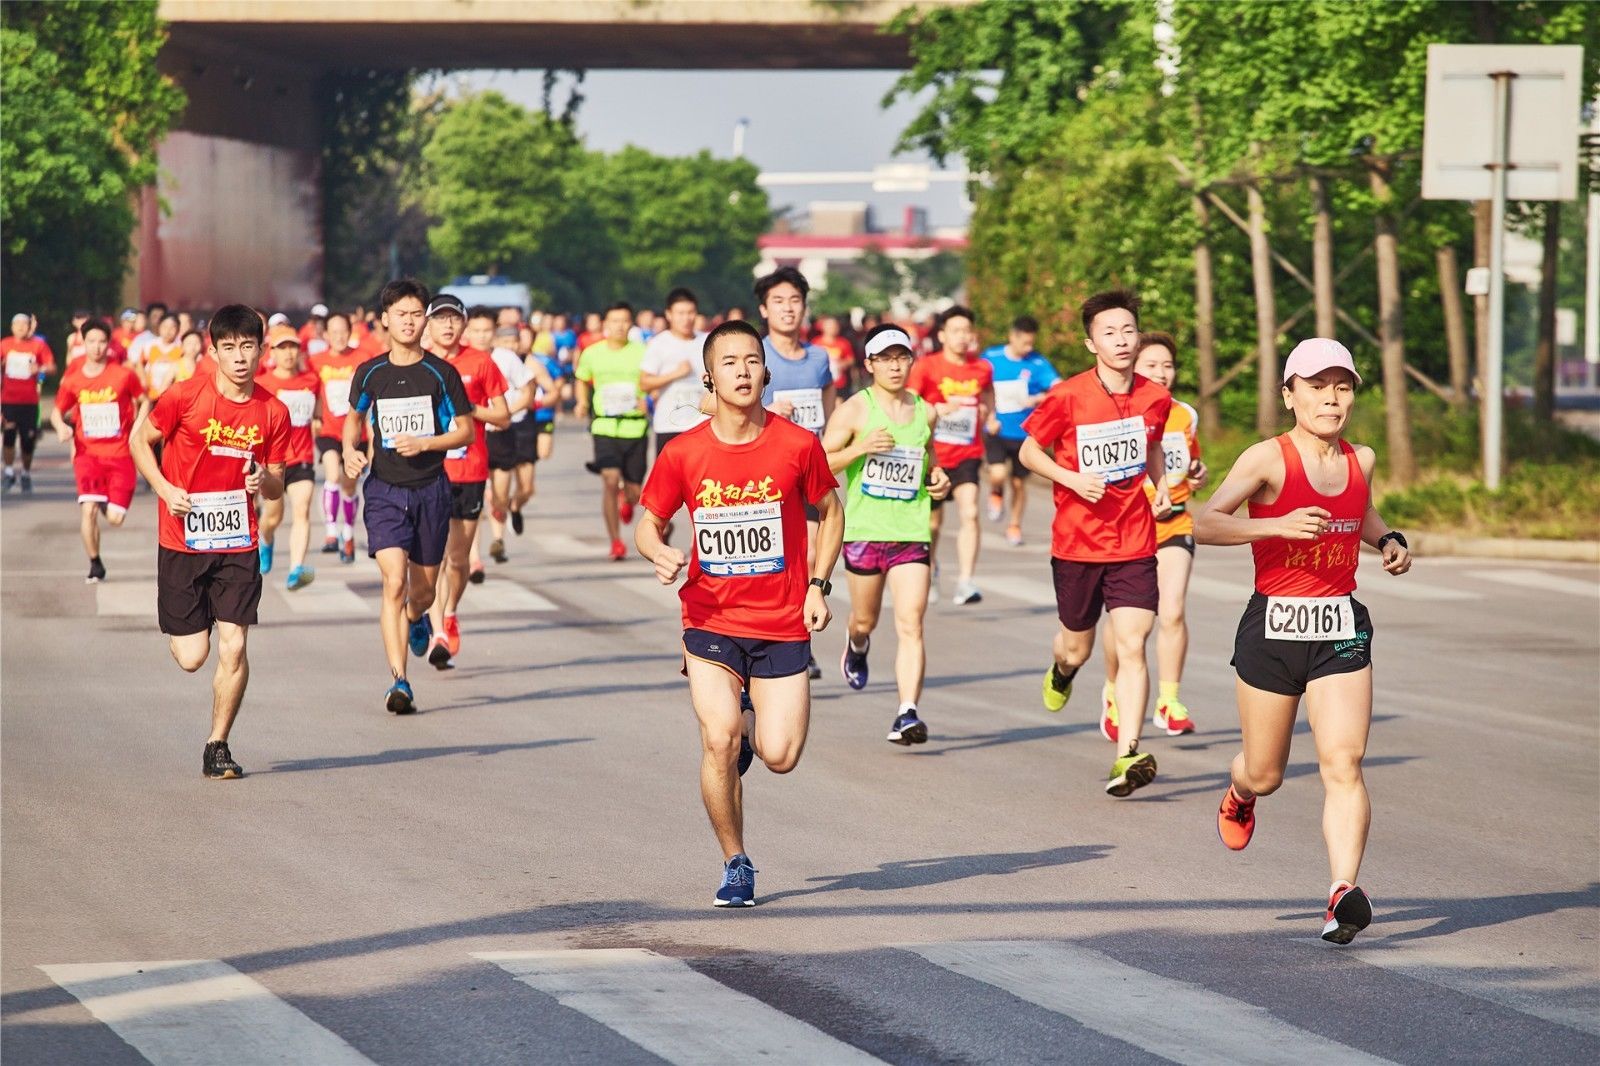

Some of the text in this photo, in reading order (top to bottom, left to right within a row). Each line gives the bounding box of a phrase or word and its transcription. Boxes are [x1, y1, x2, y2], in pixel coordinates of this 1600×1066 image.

[381, 414, 425, 433] C10767
[1081, 438, 1139, 467] C10778
[867, 458, 915, 483] C10324
[696, 476, 782, 508] 敢为人先
[187, 509, 241, 533] C10343
[699, 526, 771, 555] C10108
[1269, 602, 1342, 633] C20161
